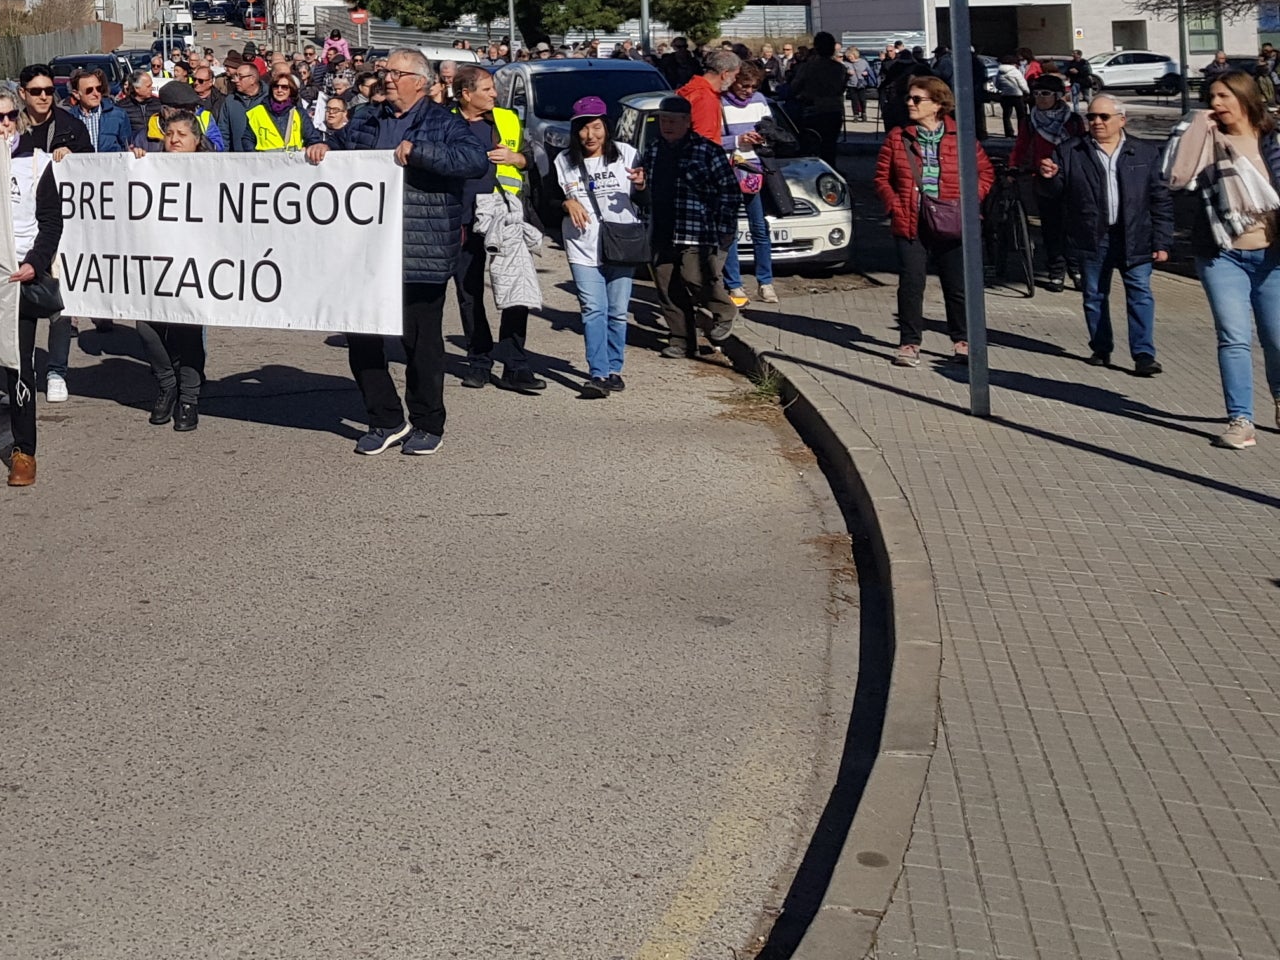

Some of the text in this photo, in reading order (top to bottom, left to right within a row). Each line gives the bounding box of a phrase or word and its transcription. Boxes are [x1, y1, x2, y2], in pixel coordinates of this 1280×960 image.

[59, 181, 116, 221] BRE
[128, 180, 204, 223] DEL
[218, 181, 387, 226] NEGOCI
[769, 229, 789, 241] WD
[60, 247, 283, 303] VATITZACIÓ
